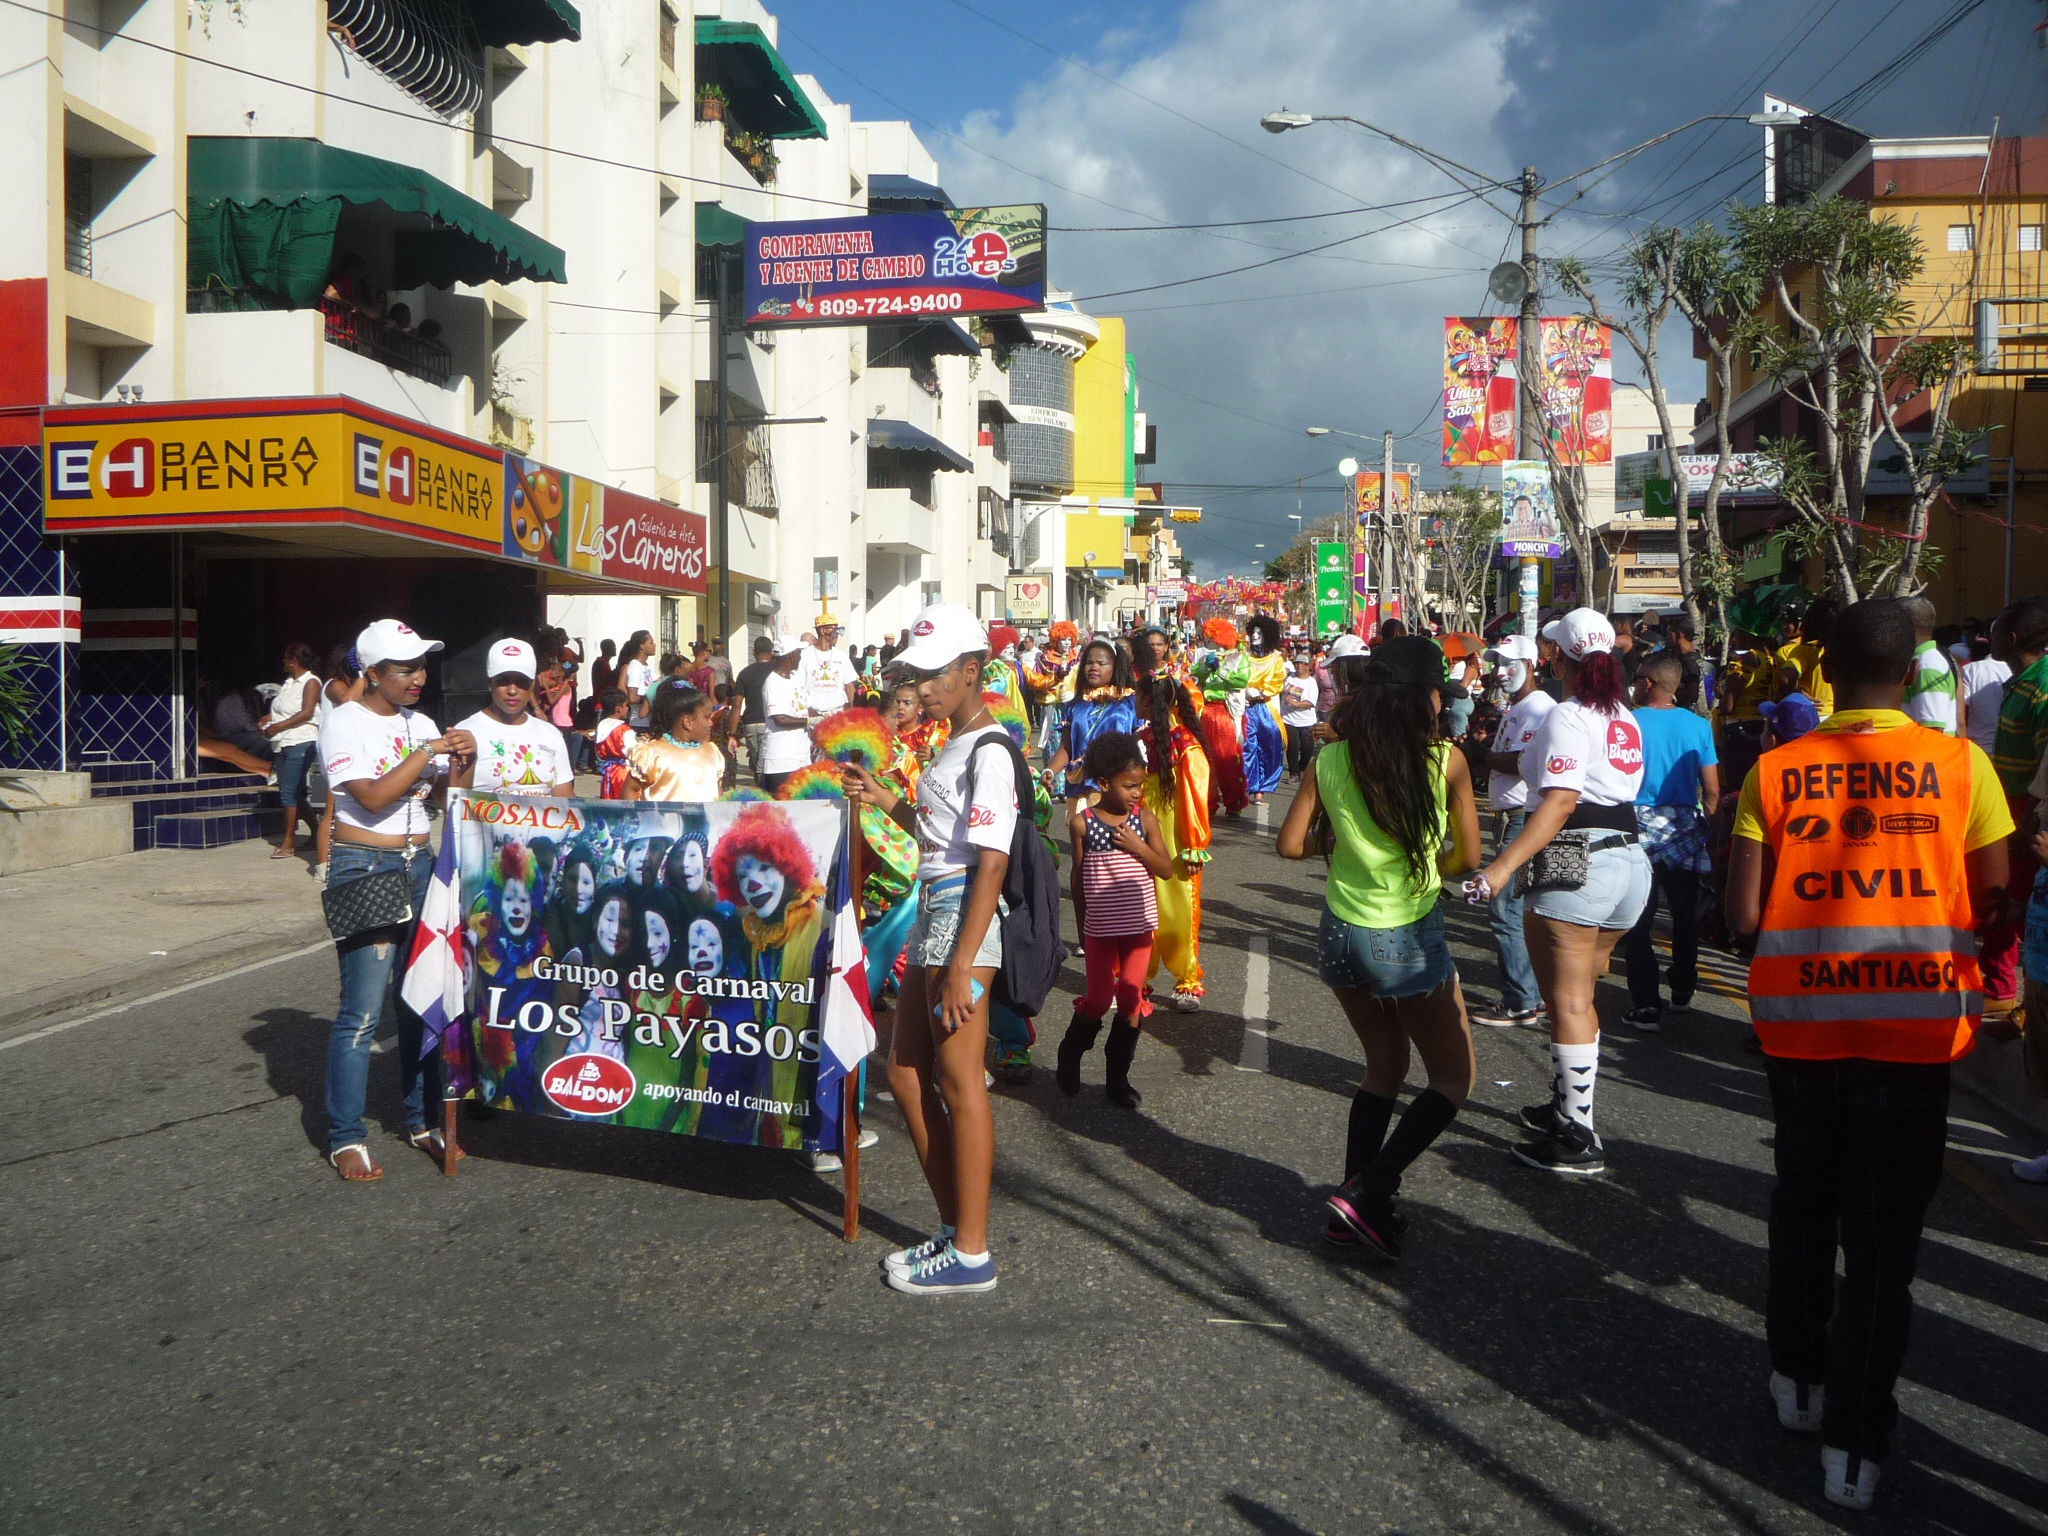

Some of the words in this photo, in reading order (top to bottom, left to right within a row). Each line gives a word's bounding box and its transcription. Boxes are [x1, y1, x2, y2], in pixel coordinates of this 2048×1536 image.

[759, 231, 873, 258] COMPRAVENTA
[935, 237, 976, 259] 24
[760, 264, 772, 285] Y
[773, 260, 833, 284] AGENTE
[837, 258, 859, 280] DE
[862, 254, 925, 280] CAMBIO
[934, 256, 1016, 276] Horas
[819, 293, 962, 316] 809-724-9400
[161, 436, 319, 467] BANCA
[1681, 455, 1719, 463] CENTR
[161, 461, 319, 491] HENRY
[418, 457, 492, 500] BANCA
[418, 481, 493, 521] HENRY
[576, 503, 619, 561] Las
[620, 518, 703, 579] Carreras
[679, 523, 696, 544] Arte
[1513, 541, 1549, 552] MONCHY
[1013, 584, 1022, 600] I
[1781, 761, 1942, 803] DEFENSA
[461, 798, 583, 831] MOSACA
[1793, 868, 1937, 900] CIVIL
[532, 955, 619, 992] Grupo
[628, 965, 664, 992] de
[675, 969, 817, 1004] Carnaval
[1800, 959, 1956, 989] SANTIAGO
[486, 986, 584, 1037] Los
[600, 999, 822, 1064] Payasos
[548, 1074, 625, 1105] BALDOM
[643, 1080, 722, 1110] apoyando
[725, 1088, 739, 1108] el
[743, 1094, 811, 1117] carnaval
[1843, 1487, 1855, 1498] 23
